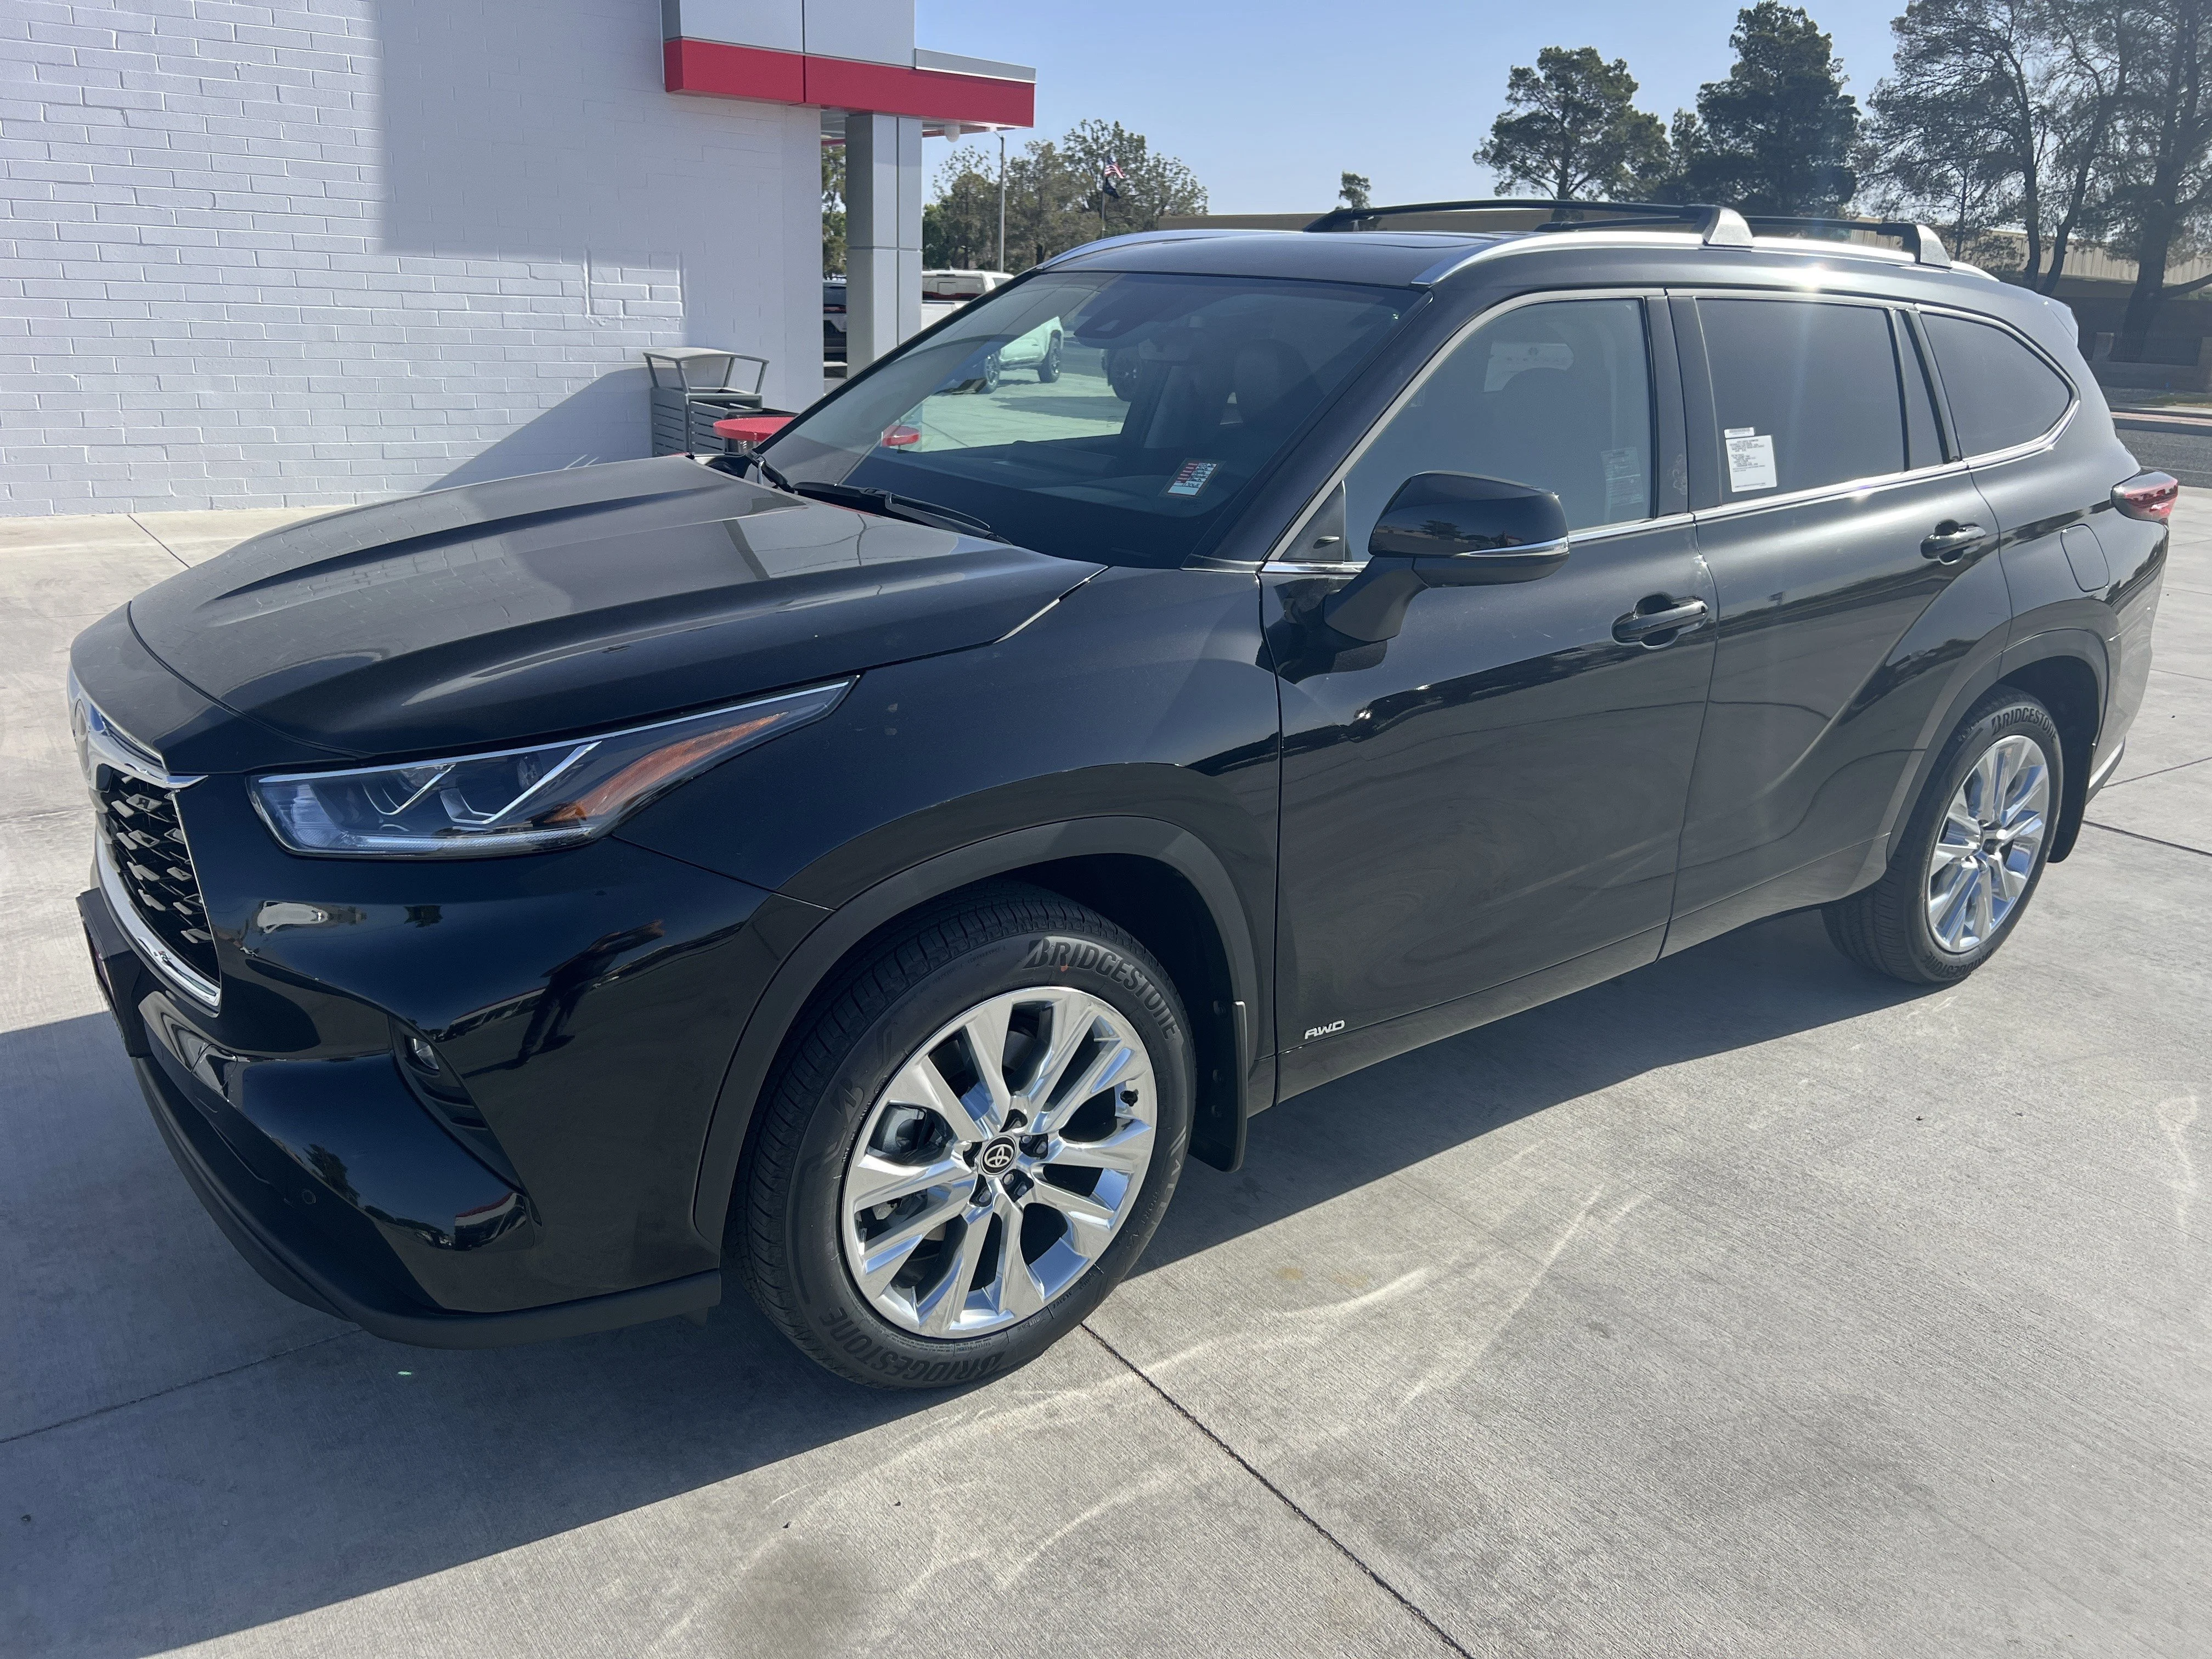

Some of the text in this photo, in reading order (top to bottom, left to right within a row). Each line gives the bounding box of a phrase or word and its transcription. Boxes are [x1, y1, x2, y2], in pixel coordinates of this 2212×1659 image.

[1991, 707, 2057, 743] BRIDGESTONE
[1022, 938, 1182, 1041] BRIDGESTONE
[1304, 1020, 1345, 1040] AWD
[1141, 1188, 1161, 1227] SPORT
[817, 1306, 1005, 1383] BRIDGESTONE
